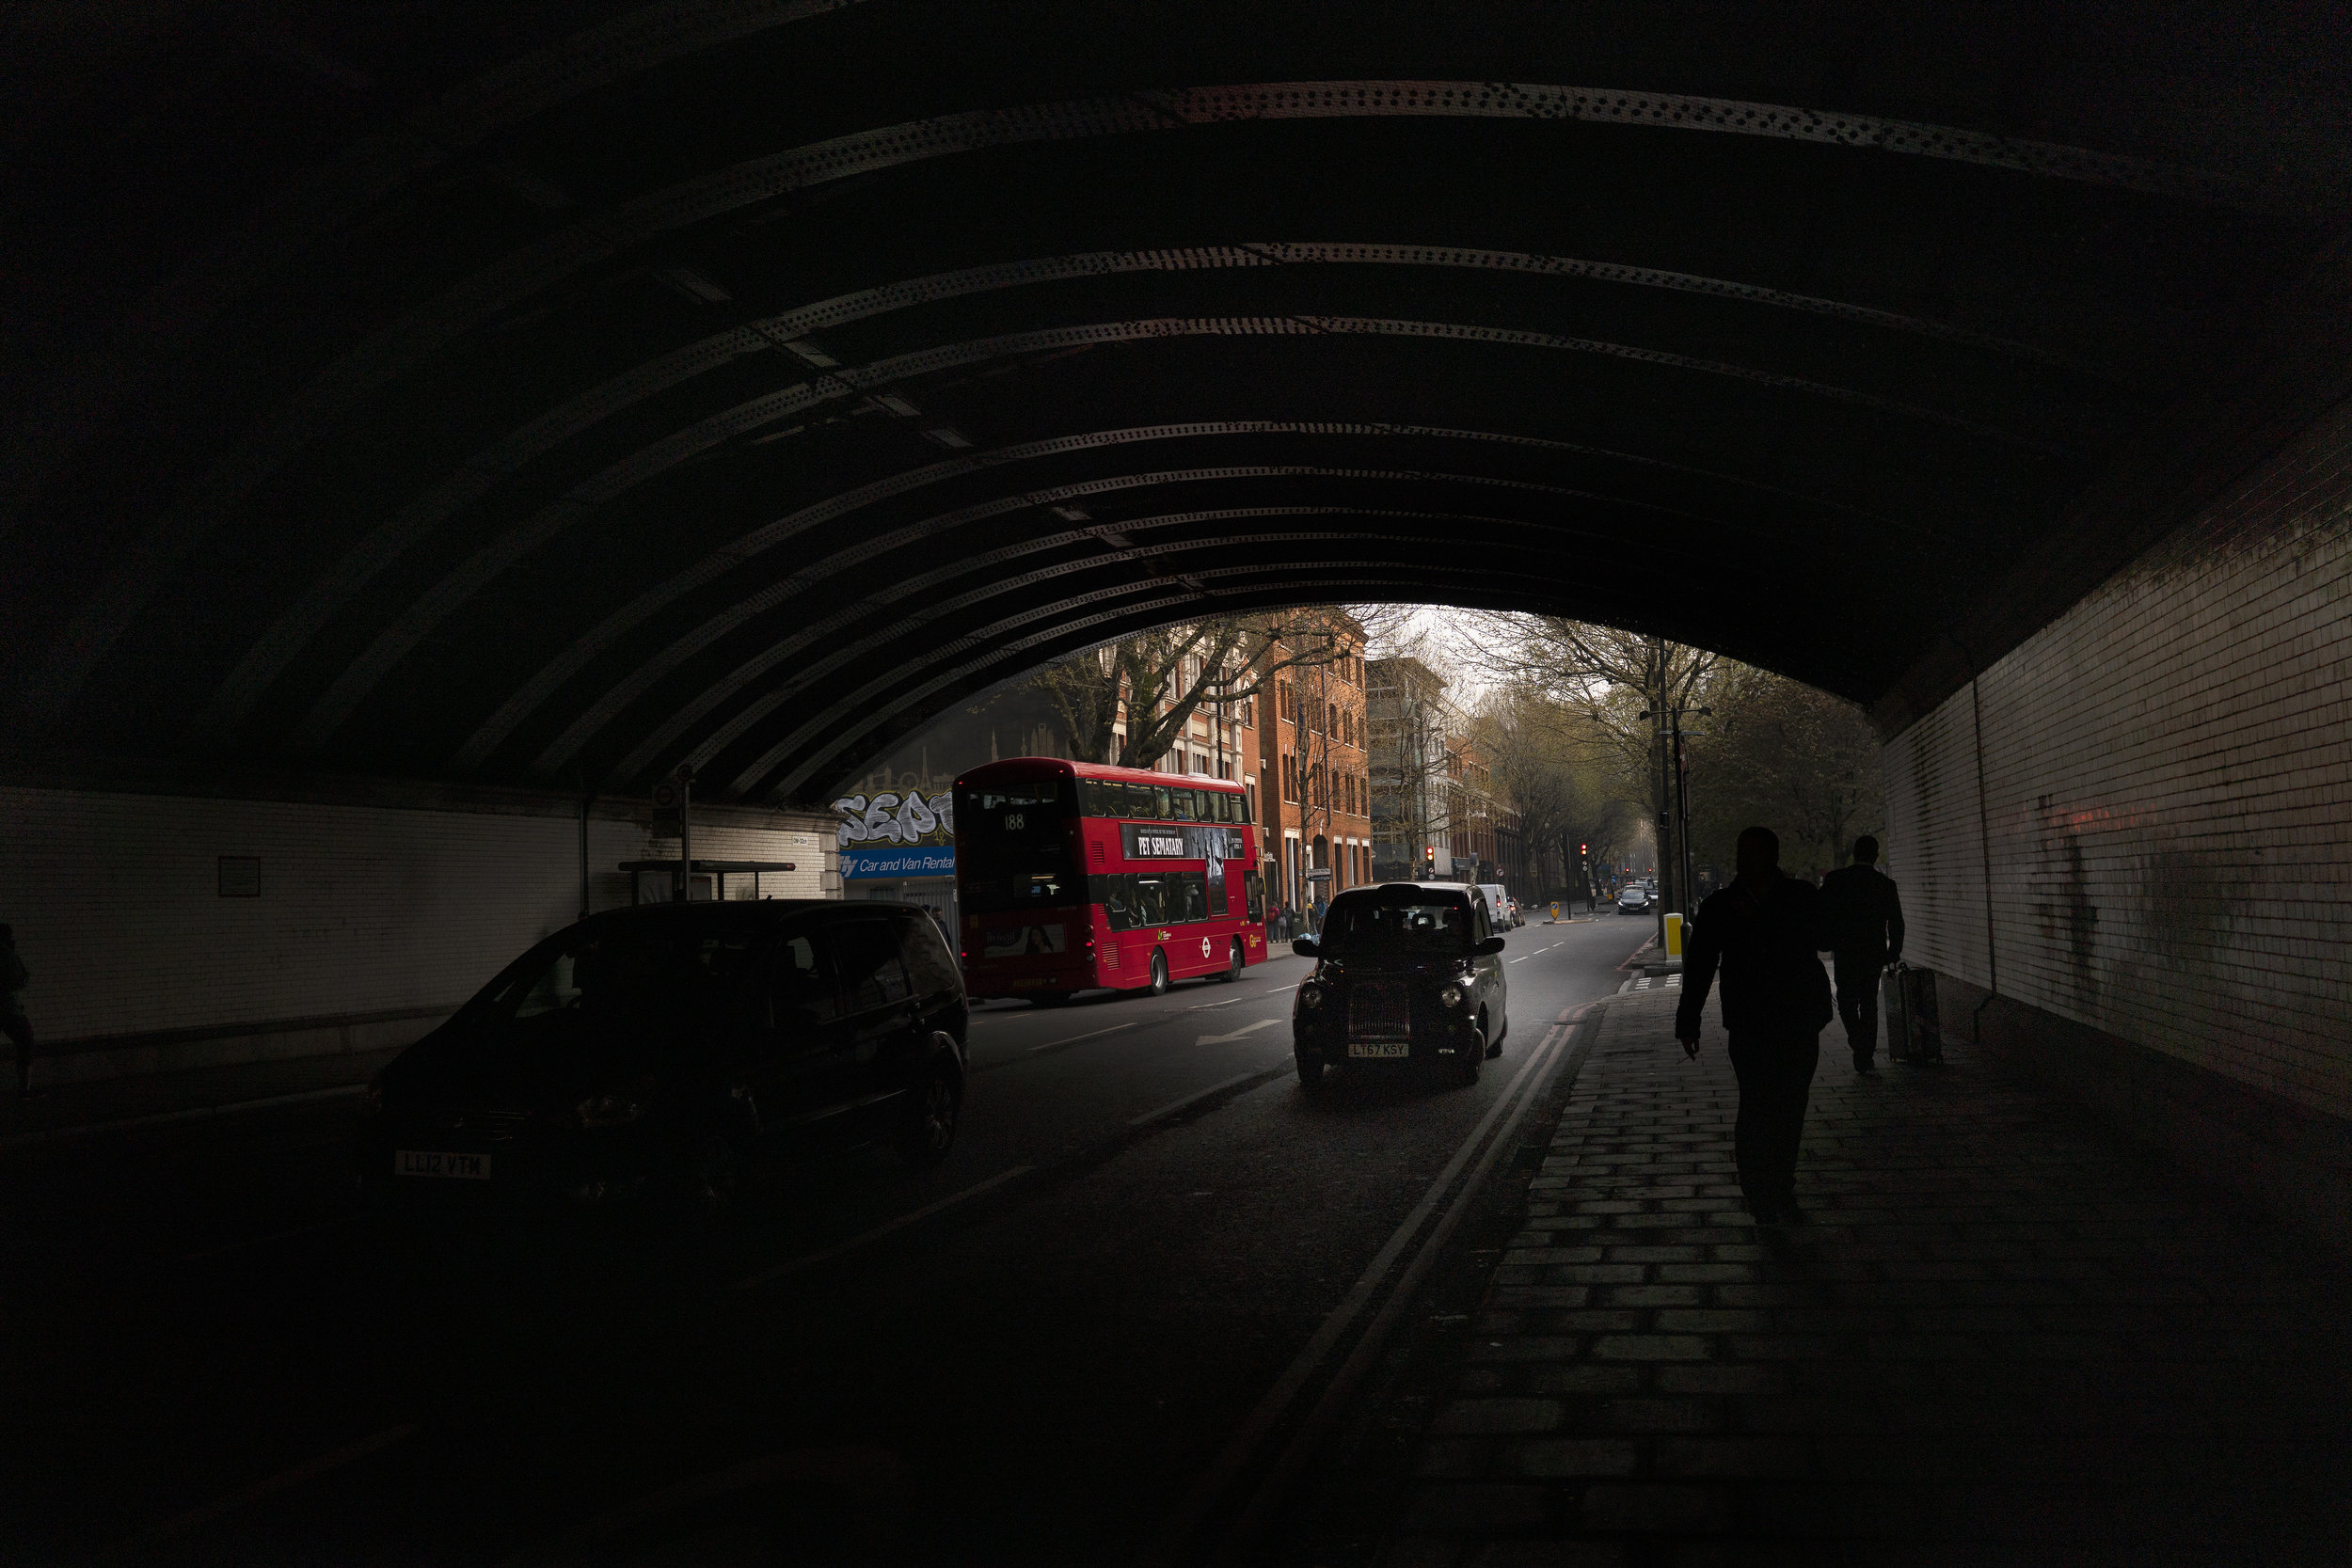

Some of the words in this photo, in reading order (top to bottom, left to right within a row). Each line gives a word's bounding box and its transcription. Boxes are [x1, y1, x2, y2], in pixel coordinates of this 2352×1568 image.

[1004, 813, 1025, 831] 188
[1137, 836, 1151, 856] PET
[1152, 837, 1184, 856] SEMATARY
[860, 859, 880, 873] Car
[880, 858, 901, 872] and
[902, 857, 921, 871] Van
[921, 855, 956, 870] Rental
[1383, 1044, 1405, 1055] KSY
